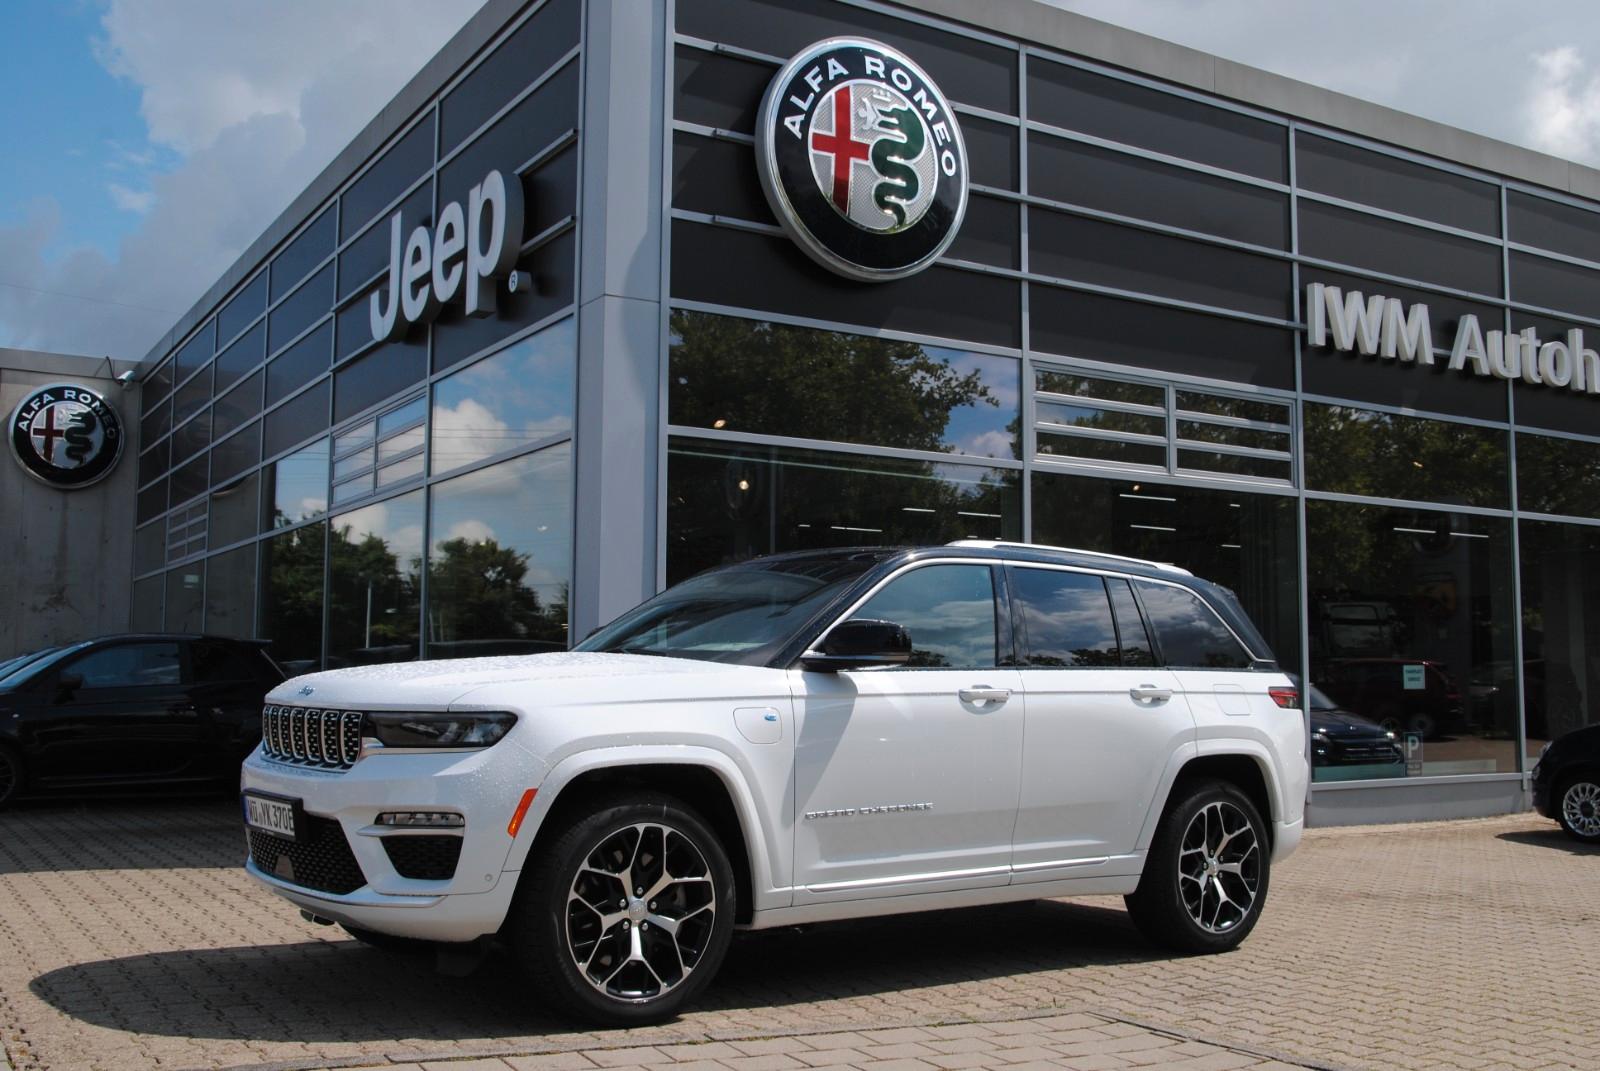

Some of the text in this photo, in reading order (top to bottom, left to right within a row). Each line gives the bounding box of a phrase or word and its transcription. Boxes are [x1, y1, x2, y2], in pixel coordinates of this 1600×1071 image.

[784, 55, 957, 177] ALFA ROMEO
[370, 169, 506, 342] Jeep
[1306, 282, 1600, 394] IWM Autoh
[18, 389, 116, 439] ALFA ROMEO
[1408, 735, 1419, 758] P
